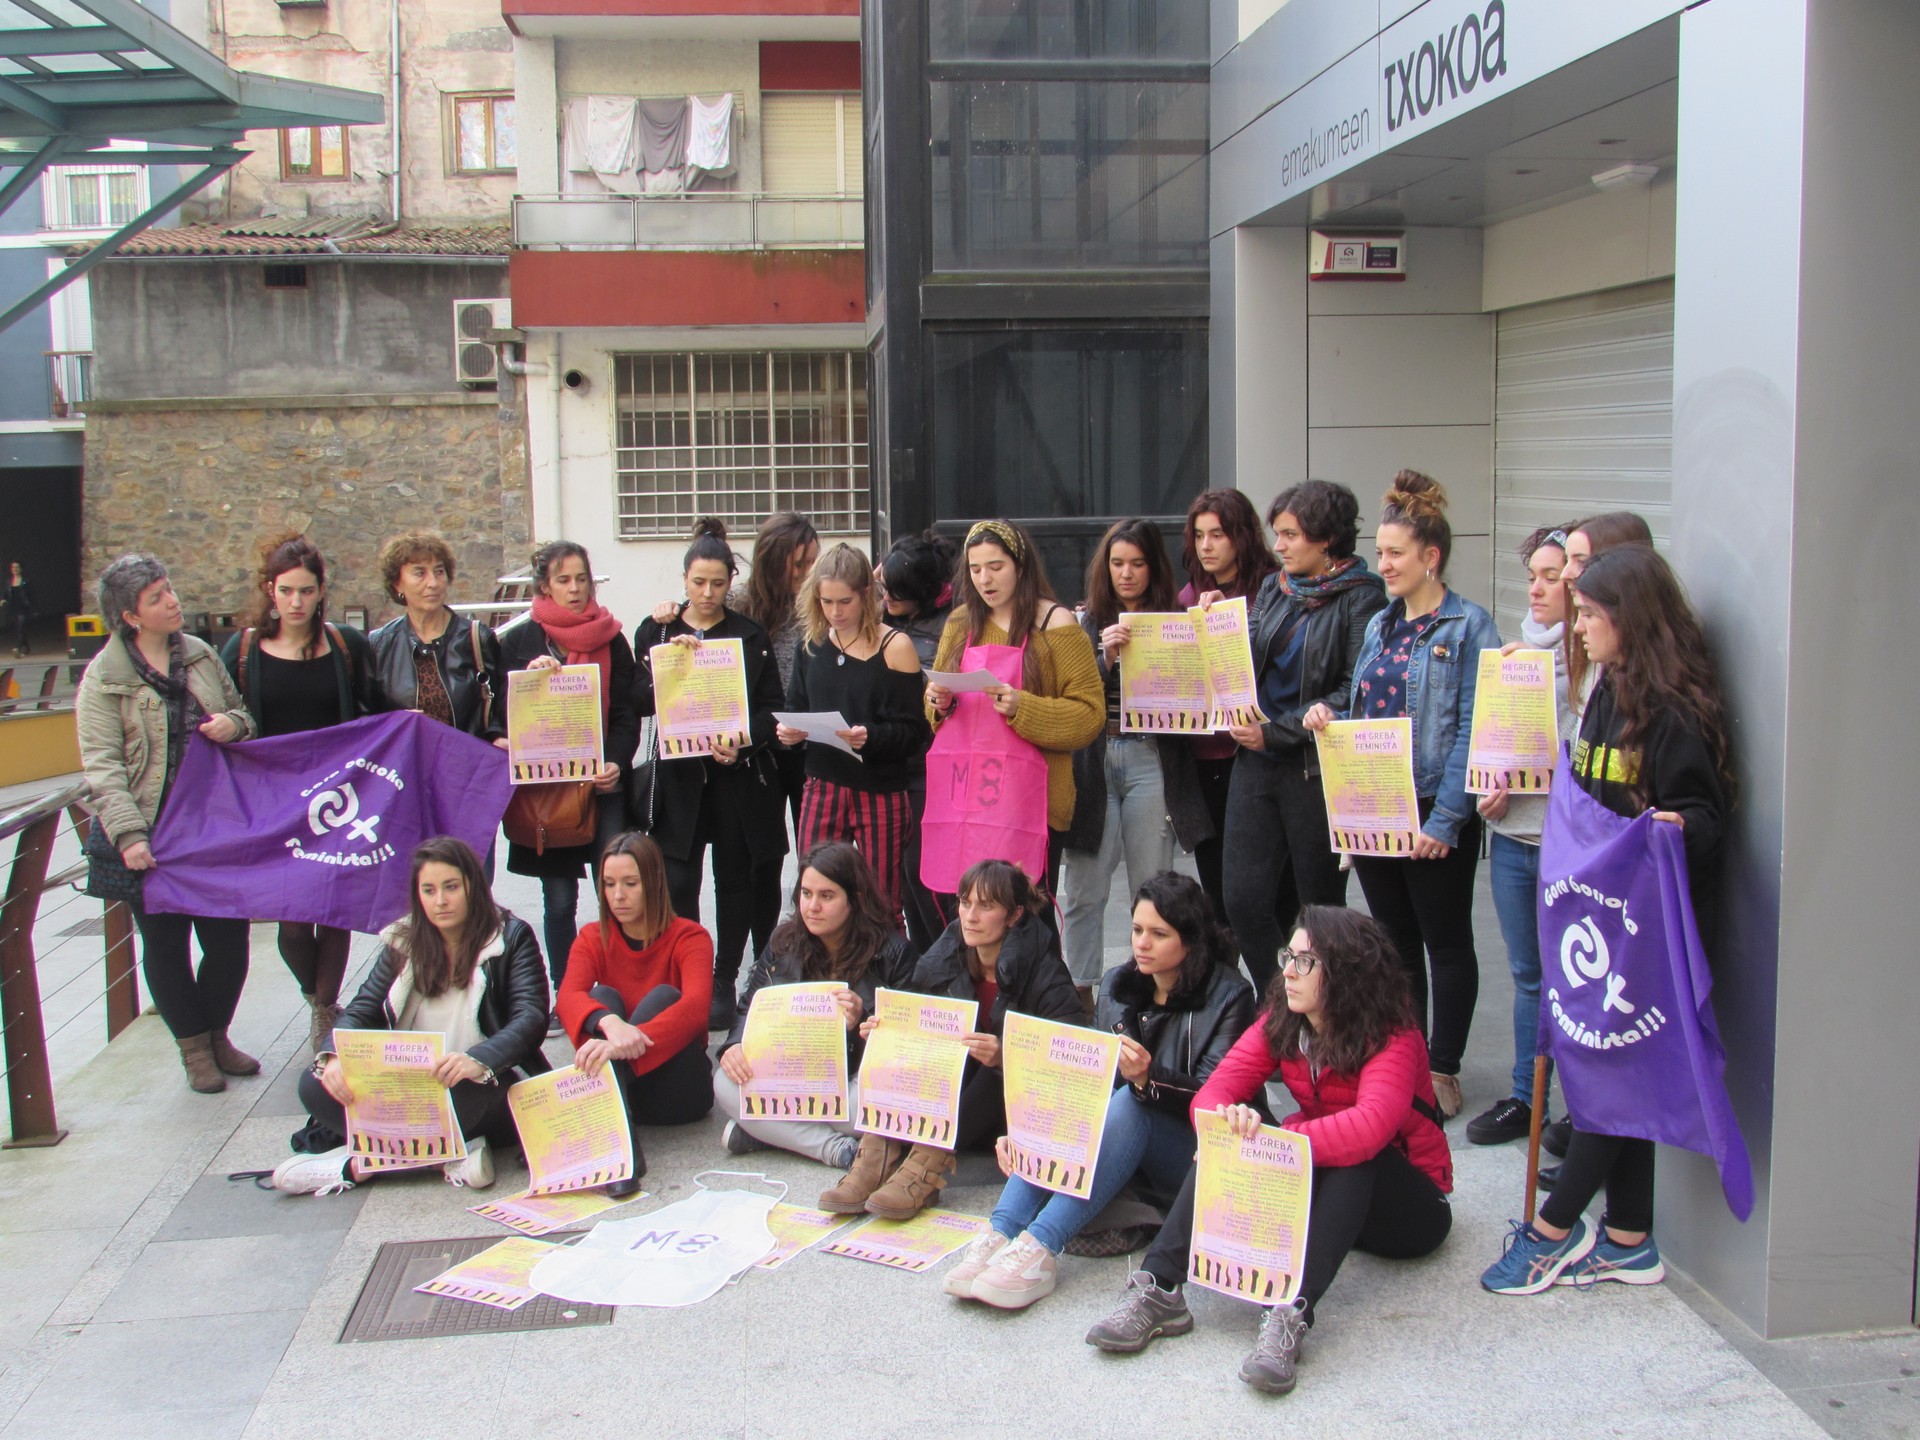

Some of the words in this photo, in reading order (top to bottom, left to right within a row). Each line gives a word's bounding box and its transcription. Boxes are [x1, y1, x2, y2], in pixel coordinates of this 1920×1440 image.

[1282, 108, 1370, 187] emakumeen
[1205, 616, 1214, 624] M8
[1215, 612, 1235, 621] GREBA
[1207, 622, 1237, 633] FEMINISTA
[694, 650, 704, 658] M8
[706, 649, 730, 657] GREBA
[694, 658, 732, 666] FEMINISTA
[1502, 663, 1512, 671] M8
[1514, 664, 1539, 672] GREBA
[562, 676, 586, 684] GREBA
[1502, 674, 1541, 682] FEMINISTA
[550, 684, 588, 692] FEMINISTA
[1368, 732, 1396, 740] GREBA
[1355, 742, 1398, 751] FEMINISTA
[805, 995, 832, 1003] GREBA
[920, 1009, 931, 1017] M8
[933, 1011, 959, 1021] GREBA
[920, 1020, 960, 1032] FEMINISTA
[384, 1044, 398, 1052] M8
[400, 1044, 429, 1053] GREBA
[1052, 1038, 1066, 1048] M8
[1068, 1041, 1100, 1056] GREBA
[384, 1054, 430, 1064] FEMINISTA
[1050, 1050, 1100, 1068] FEMINISTA
[556, 1080, 570, 1090] M8
[570, 1073, 595, 1086] GREB
[560, 1080, 604, 1100] FEMINISTA
[1242, 1135, 1256, 1145] M8
[1260, 1137, 1294, 1152] GREBA
[1241, 1147, 1295, 1166] FEMINISTA
[630, 1230, 719, 1253] M8
